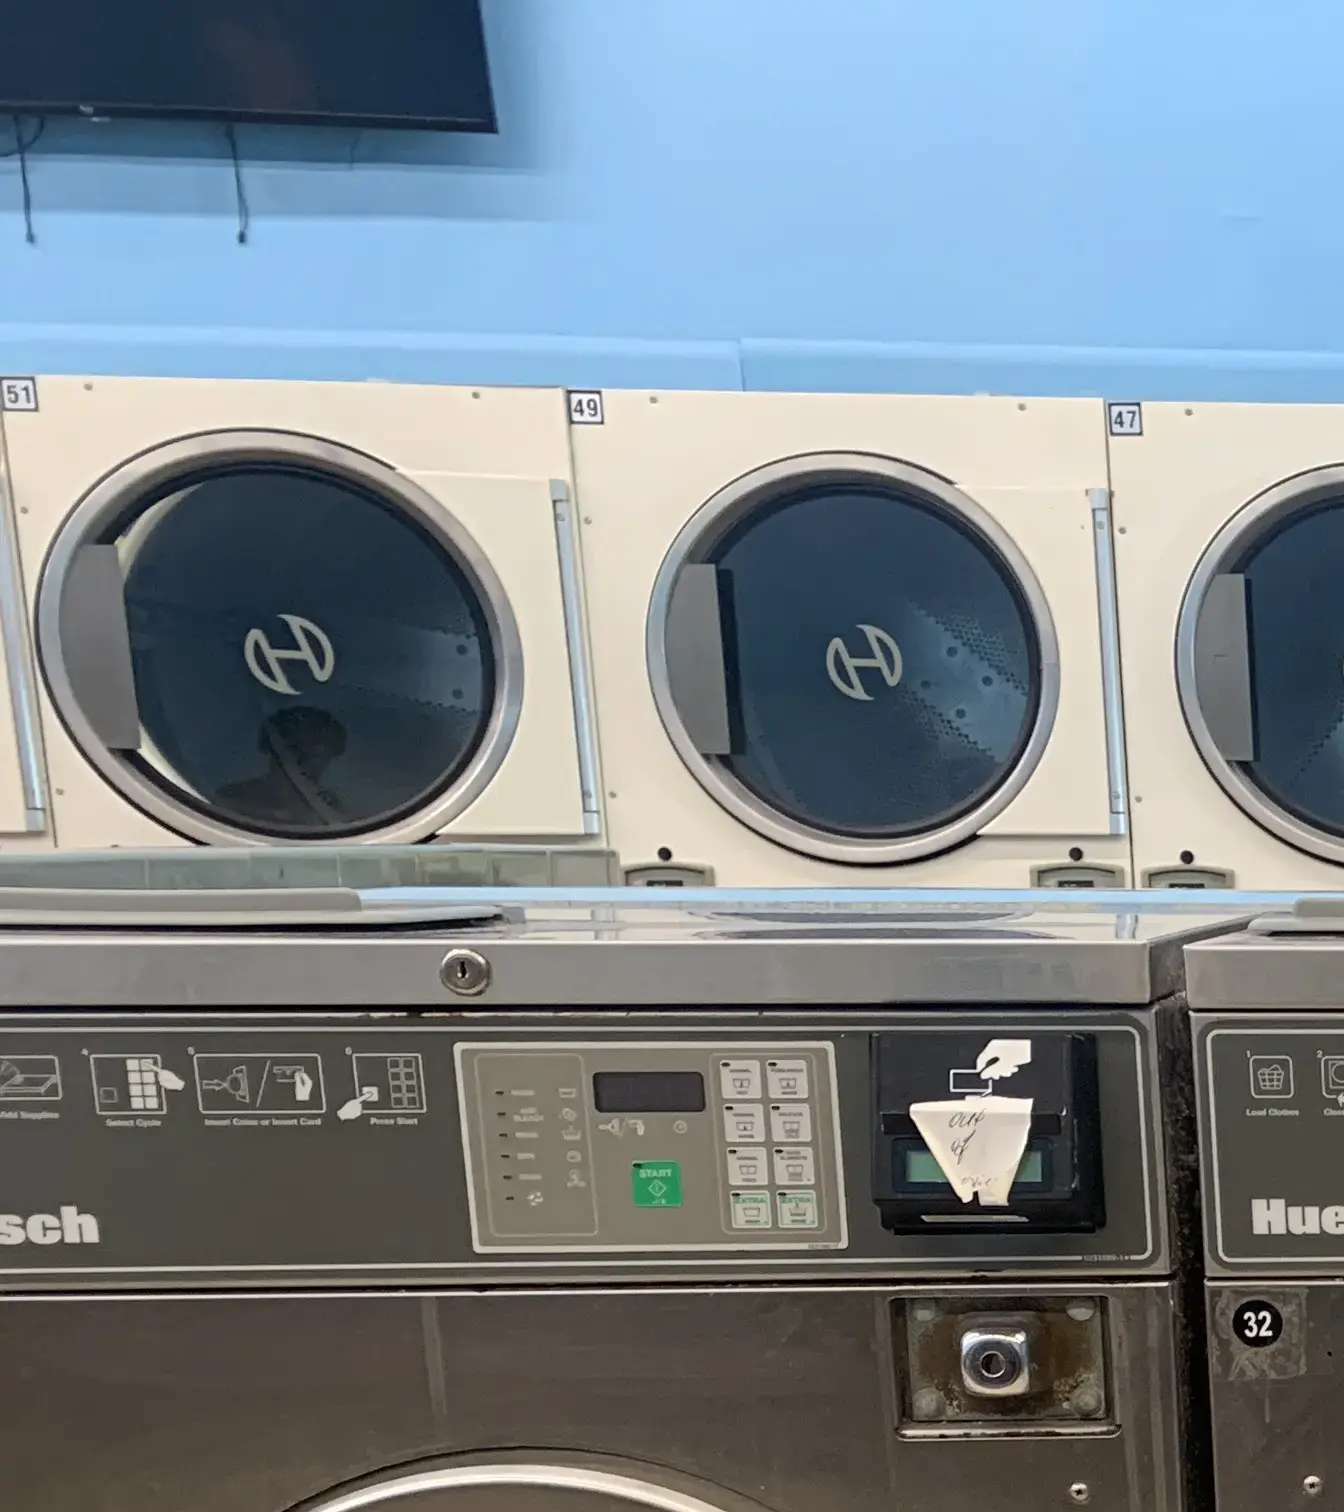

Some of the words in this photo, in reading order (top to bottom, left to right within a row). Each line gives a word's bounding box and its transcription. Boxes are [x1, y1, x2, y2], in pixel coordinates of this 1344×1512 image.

[7, 385, 31, 404] 51
[573, 399, 598, 417] 49
[1114, 411, 1137, 428] 47
[1243, 1311, 1273, 1338] 32
